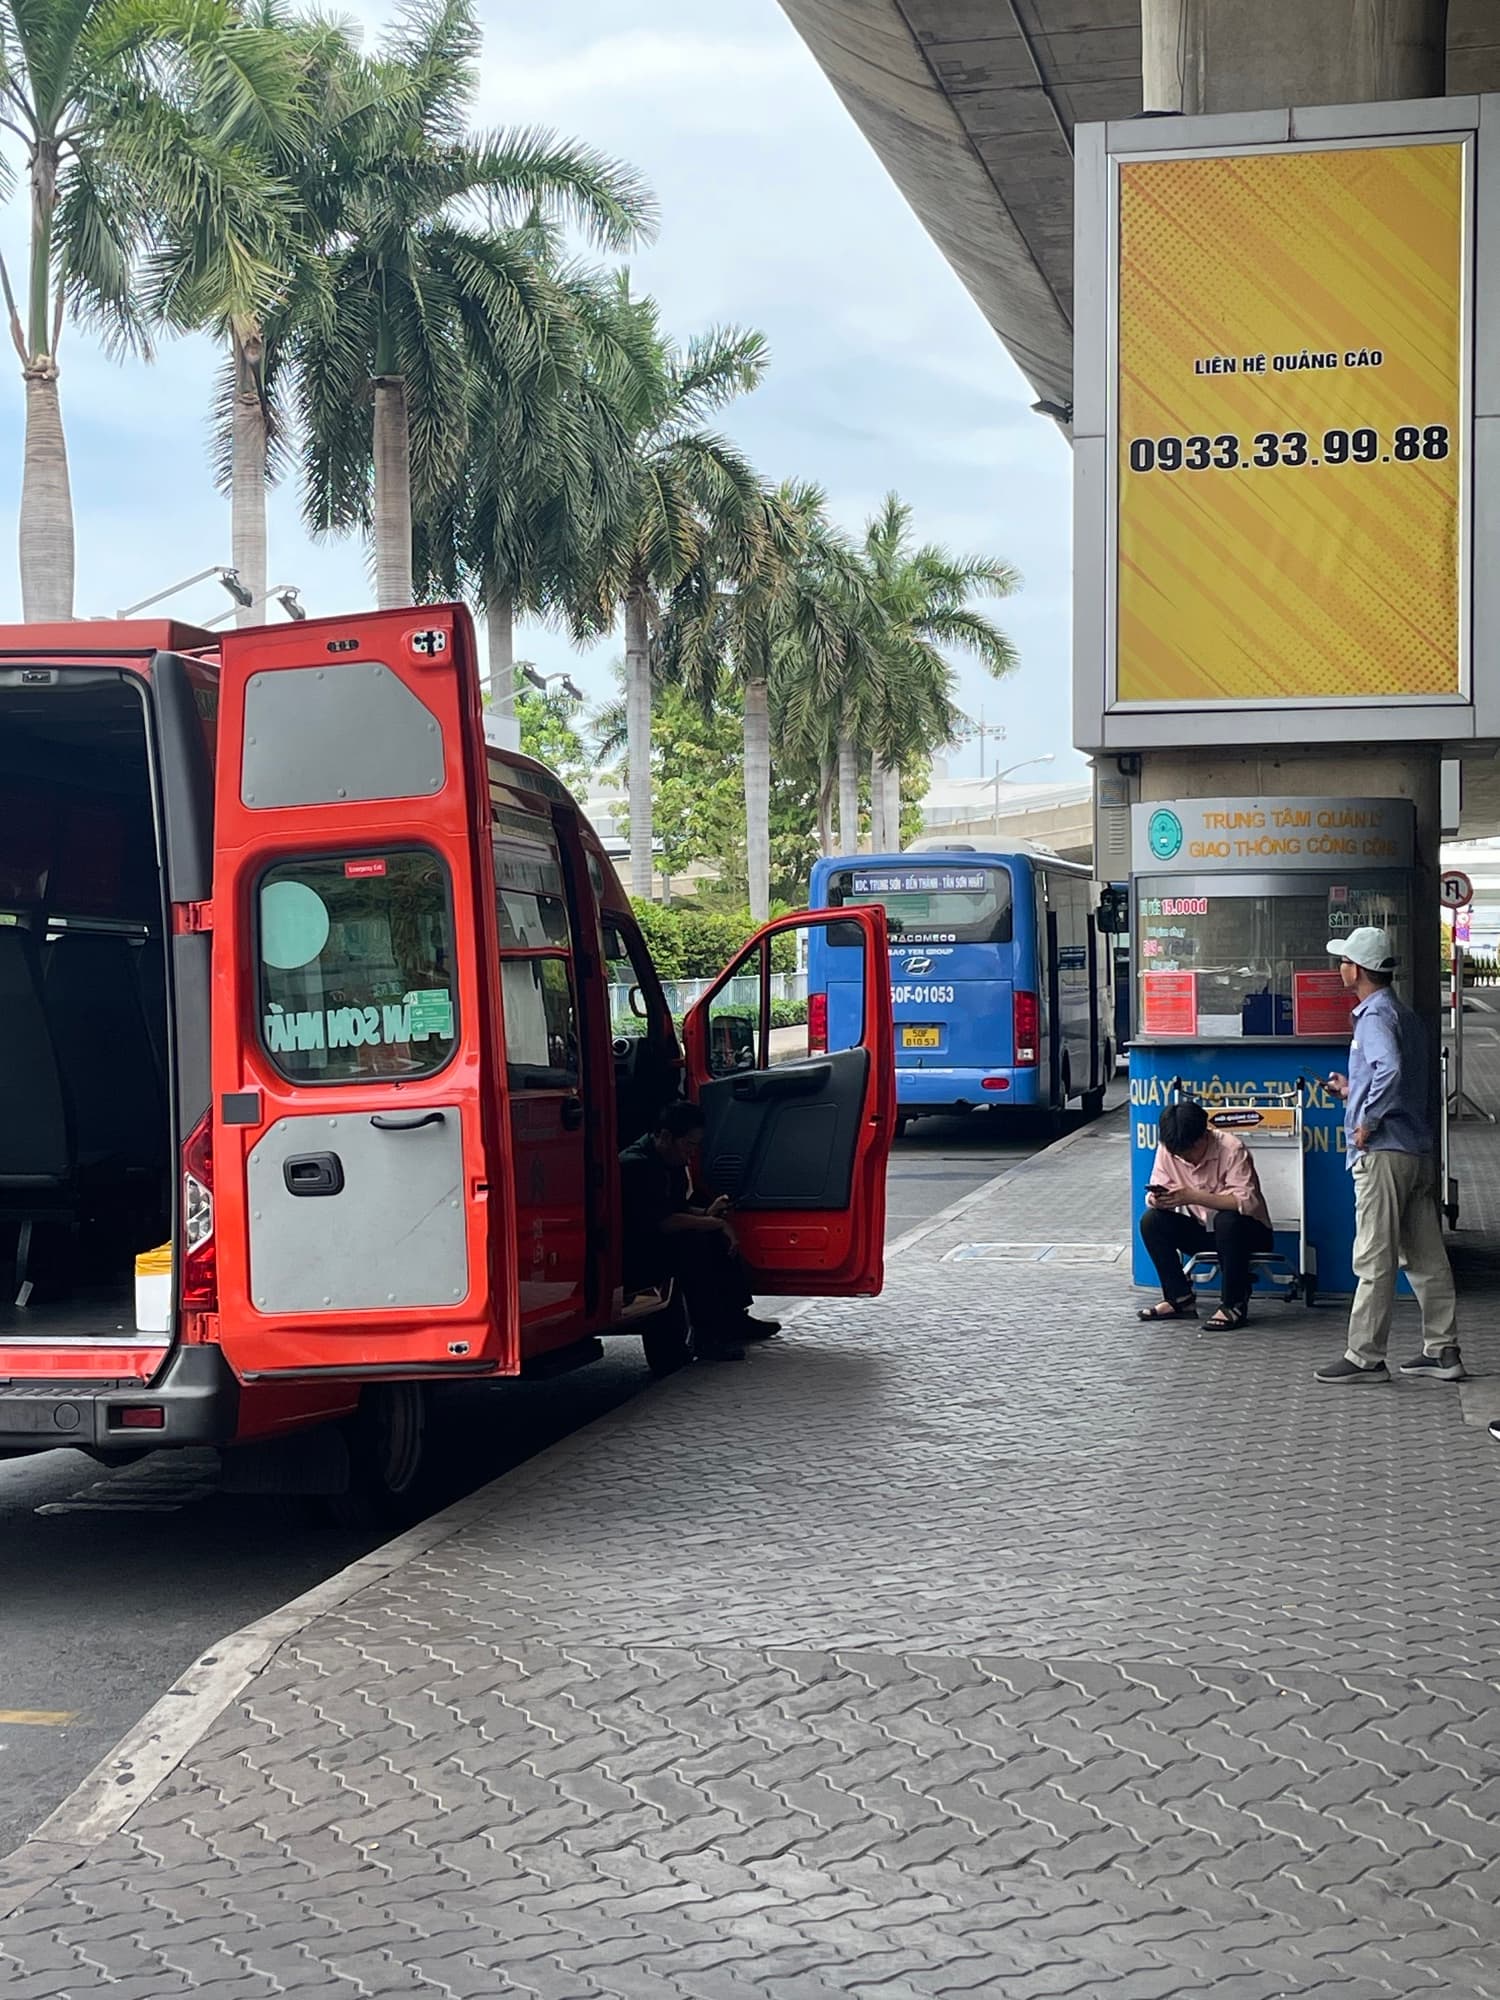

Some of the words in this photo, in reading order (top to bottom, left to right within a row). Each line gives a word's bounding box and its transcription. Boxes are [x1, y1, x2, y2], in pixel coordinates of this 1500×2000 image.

[1195, 356, 1236, 375] LIÊN
[1243, 354, 1266, 375] HỆ
[1273, 350, 1338, 372] QUẢNG
[1344, 349, 1383, 368] CÁO
[1130, 425, 1450, 473] 0933.33.99.88
[1203, 811, 1265, 829] TRUNG
[1271, 808, 1311, 828] TÂM
[1189, 840, 1231, 858] GIAO
[1234, 834, 1301, 857] THÔNG
[1306, 834, 1358, 855] CÔNG
[887, 934, 956, 943] RACOMECO
[1137, 1122, 1157, 1150] BU
